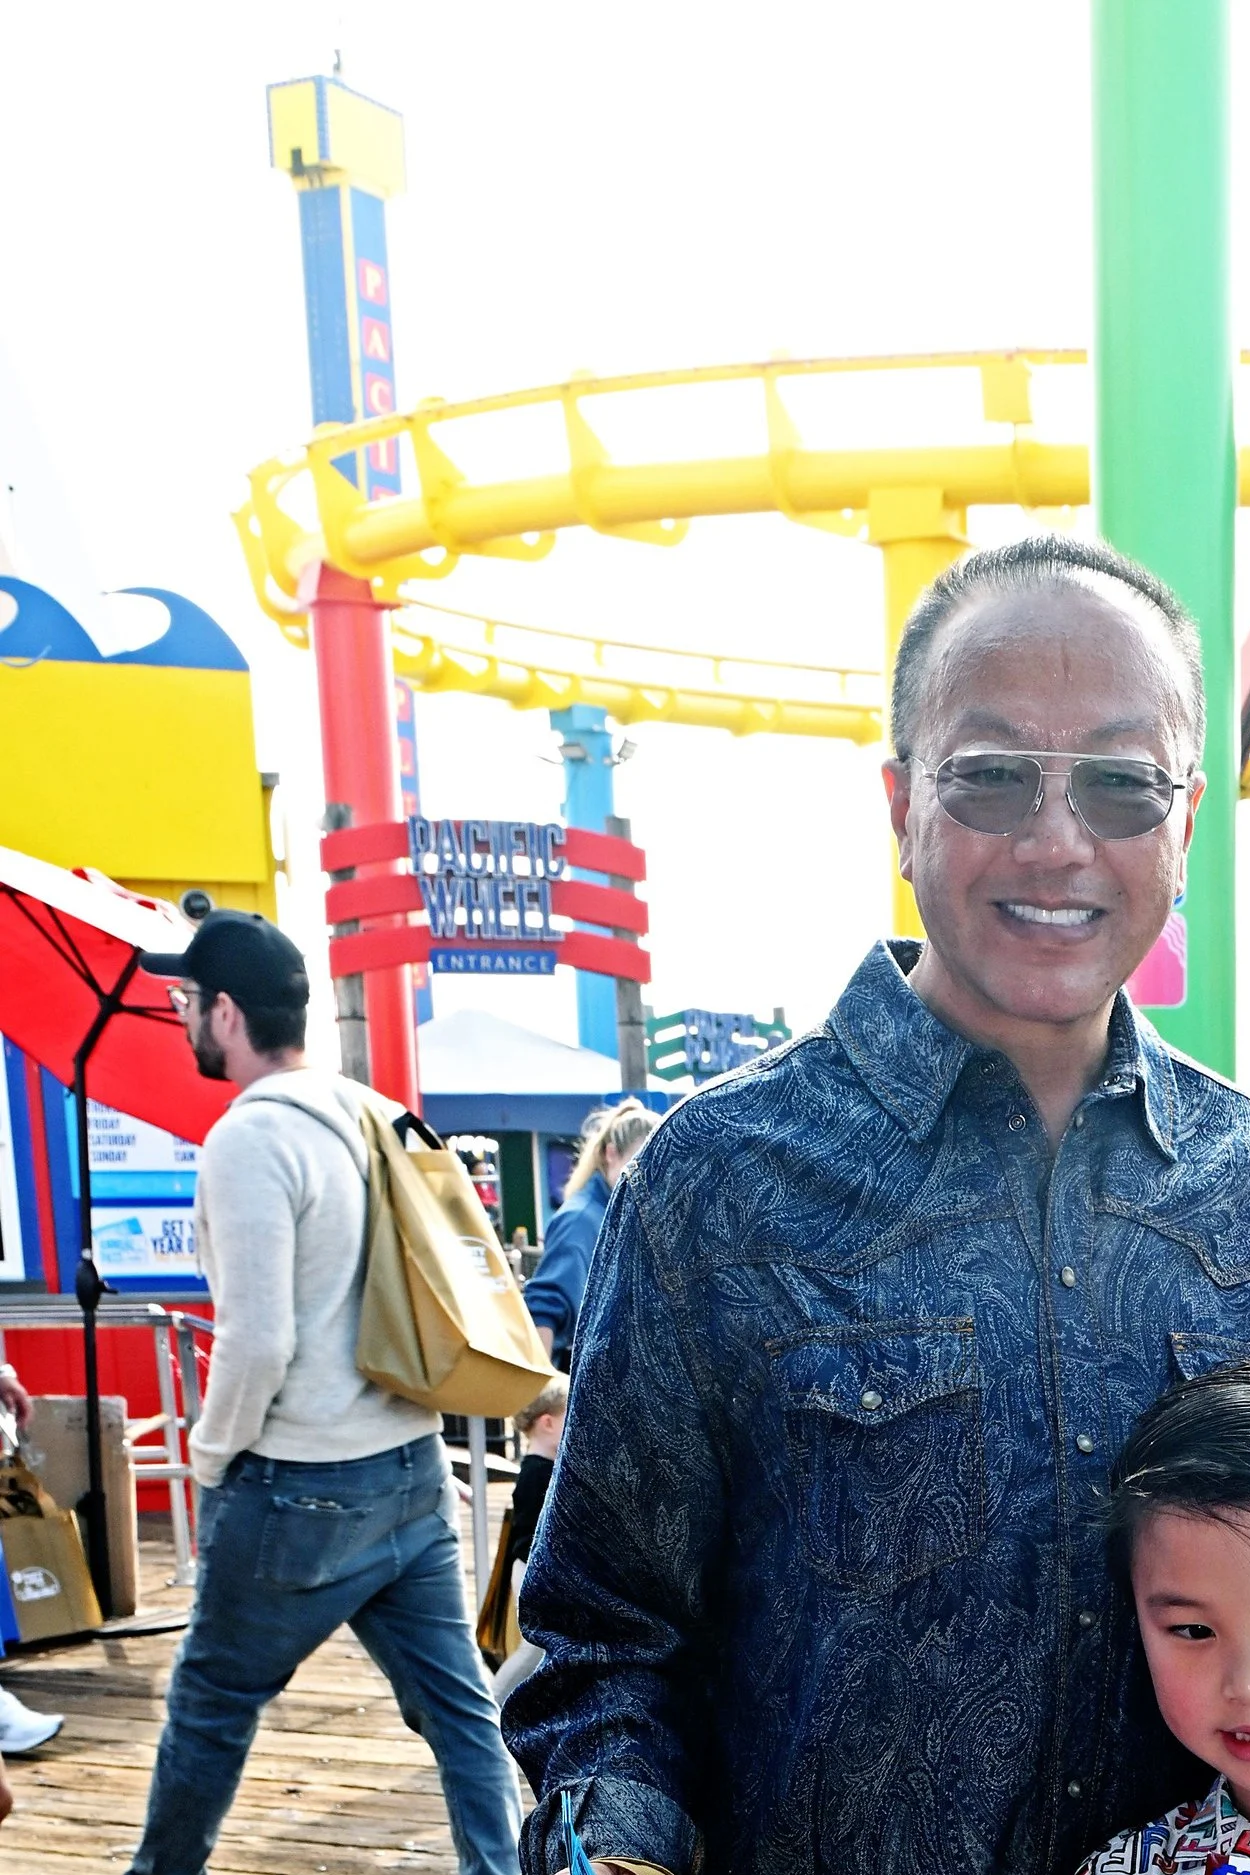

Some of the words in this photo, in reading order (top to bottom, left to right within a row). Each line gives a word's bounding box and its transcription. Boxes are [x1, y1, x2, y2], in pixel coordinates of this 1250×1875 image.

[365, 265, 393, 498] PACI
[408, 815, 567, 880] PACIFIC
[417, 875, 566, 941] WHEEL
[437, 954, 550, 972] ENTRANCE
